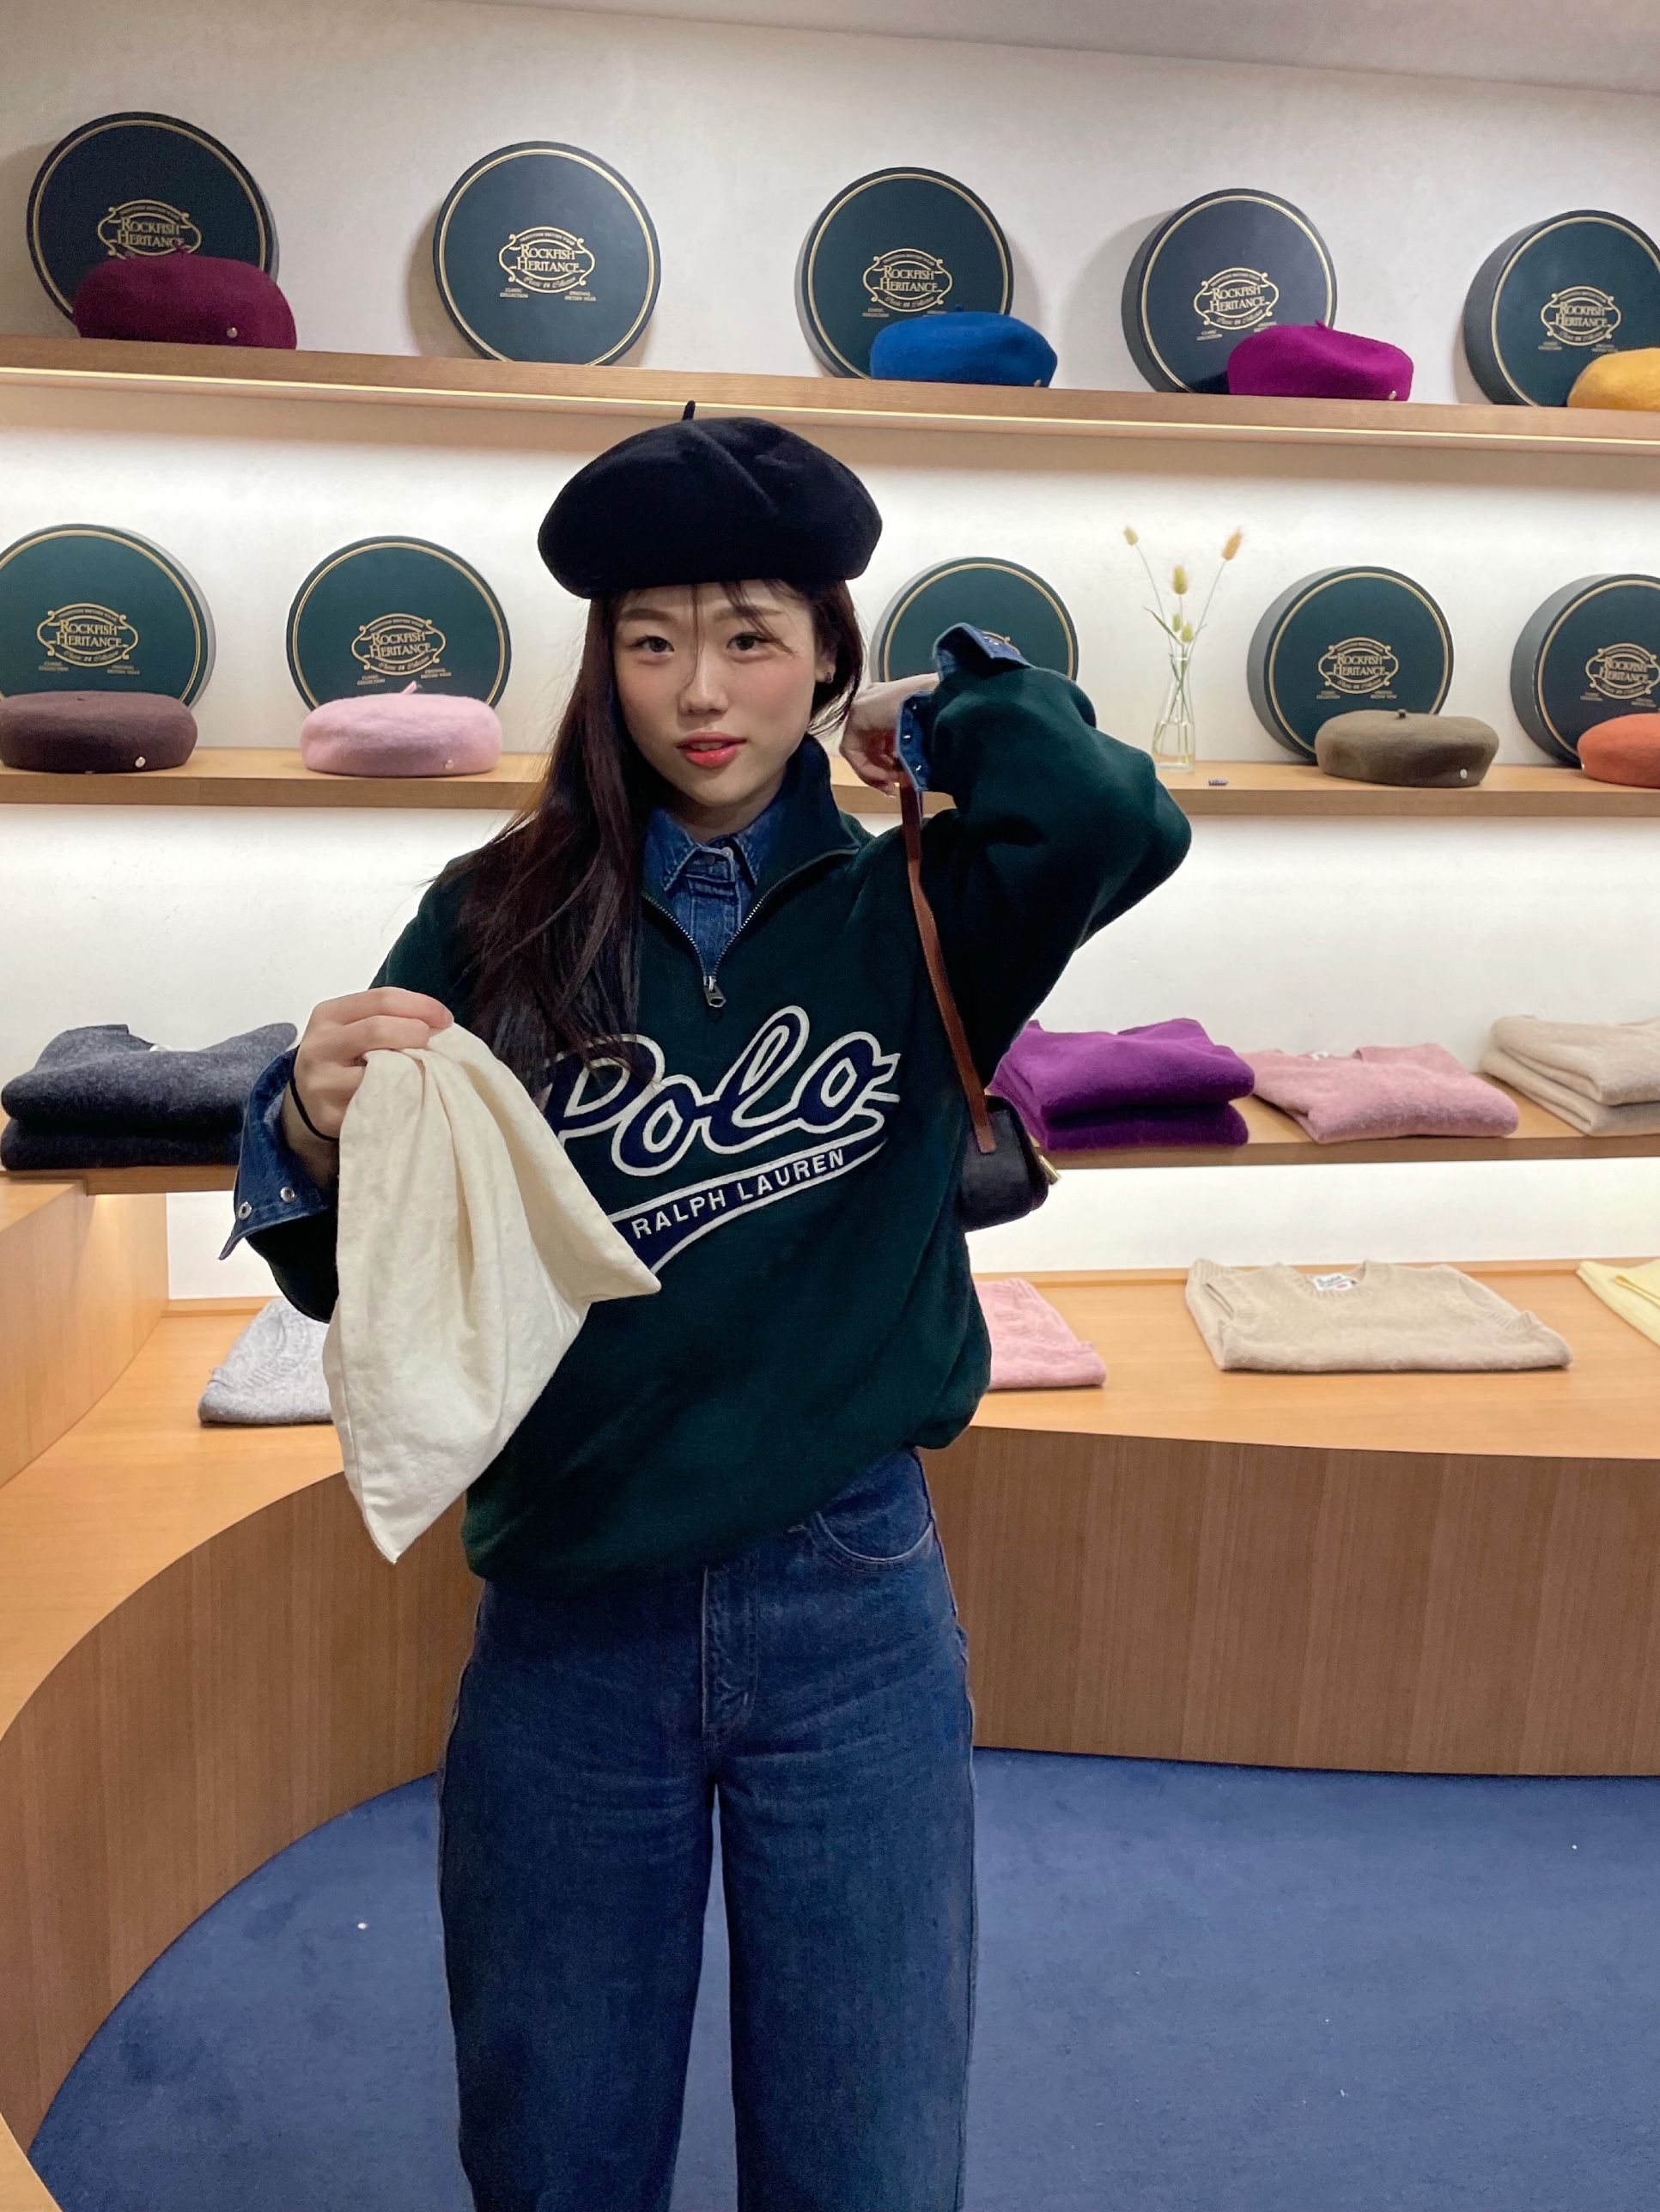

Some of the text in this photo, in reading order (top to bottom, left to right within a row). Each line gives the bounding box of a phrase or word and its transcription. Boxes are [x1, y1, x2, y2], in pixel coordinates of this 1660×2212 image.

[120, 217, 180, 234] ROCKFISH
[520, 244, 575, 260] ROCKFISH
[516, 257, 580, 272] HERITANCE
[883, 265, 934, 280] ROCKFISH
[879, 277, 939, 292] HERITANCE
[1212, 285, 1261, 301] ROCKFISH
[1209, 296, 1266, 313] HERITANCE
[60, 619, 118, 635] ROCKFISH
[56, 631, 122, 647] HERITANCE
[371, 631, 426, 646] ROCKFISH
[368, 642, 431, 658] HERITANCE
[1337, 653, 1383, 665] ROCKFISH
[1333, 664, 1385, 676] HERITANCE
[544, 1006, 901, 1176] Polo
[631, 1148, 844, 1239] RALPH LAUREN
